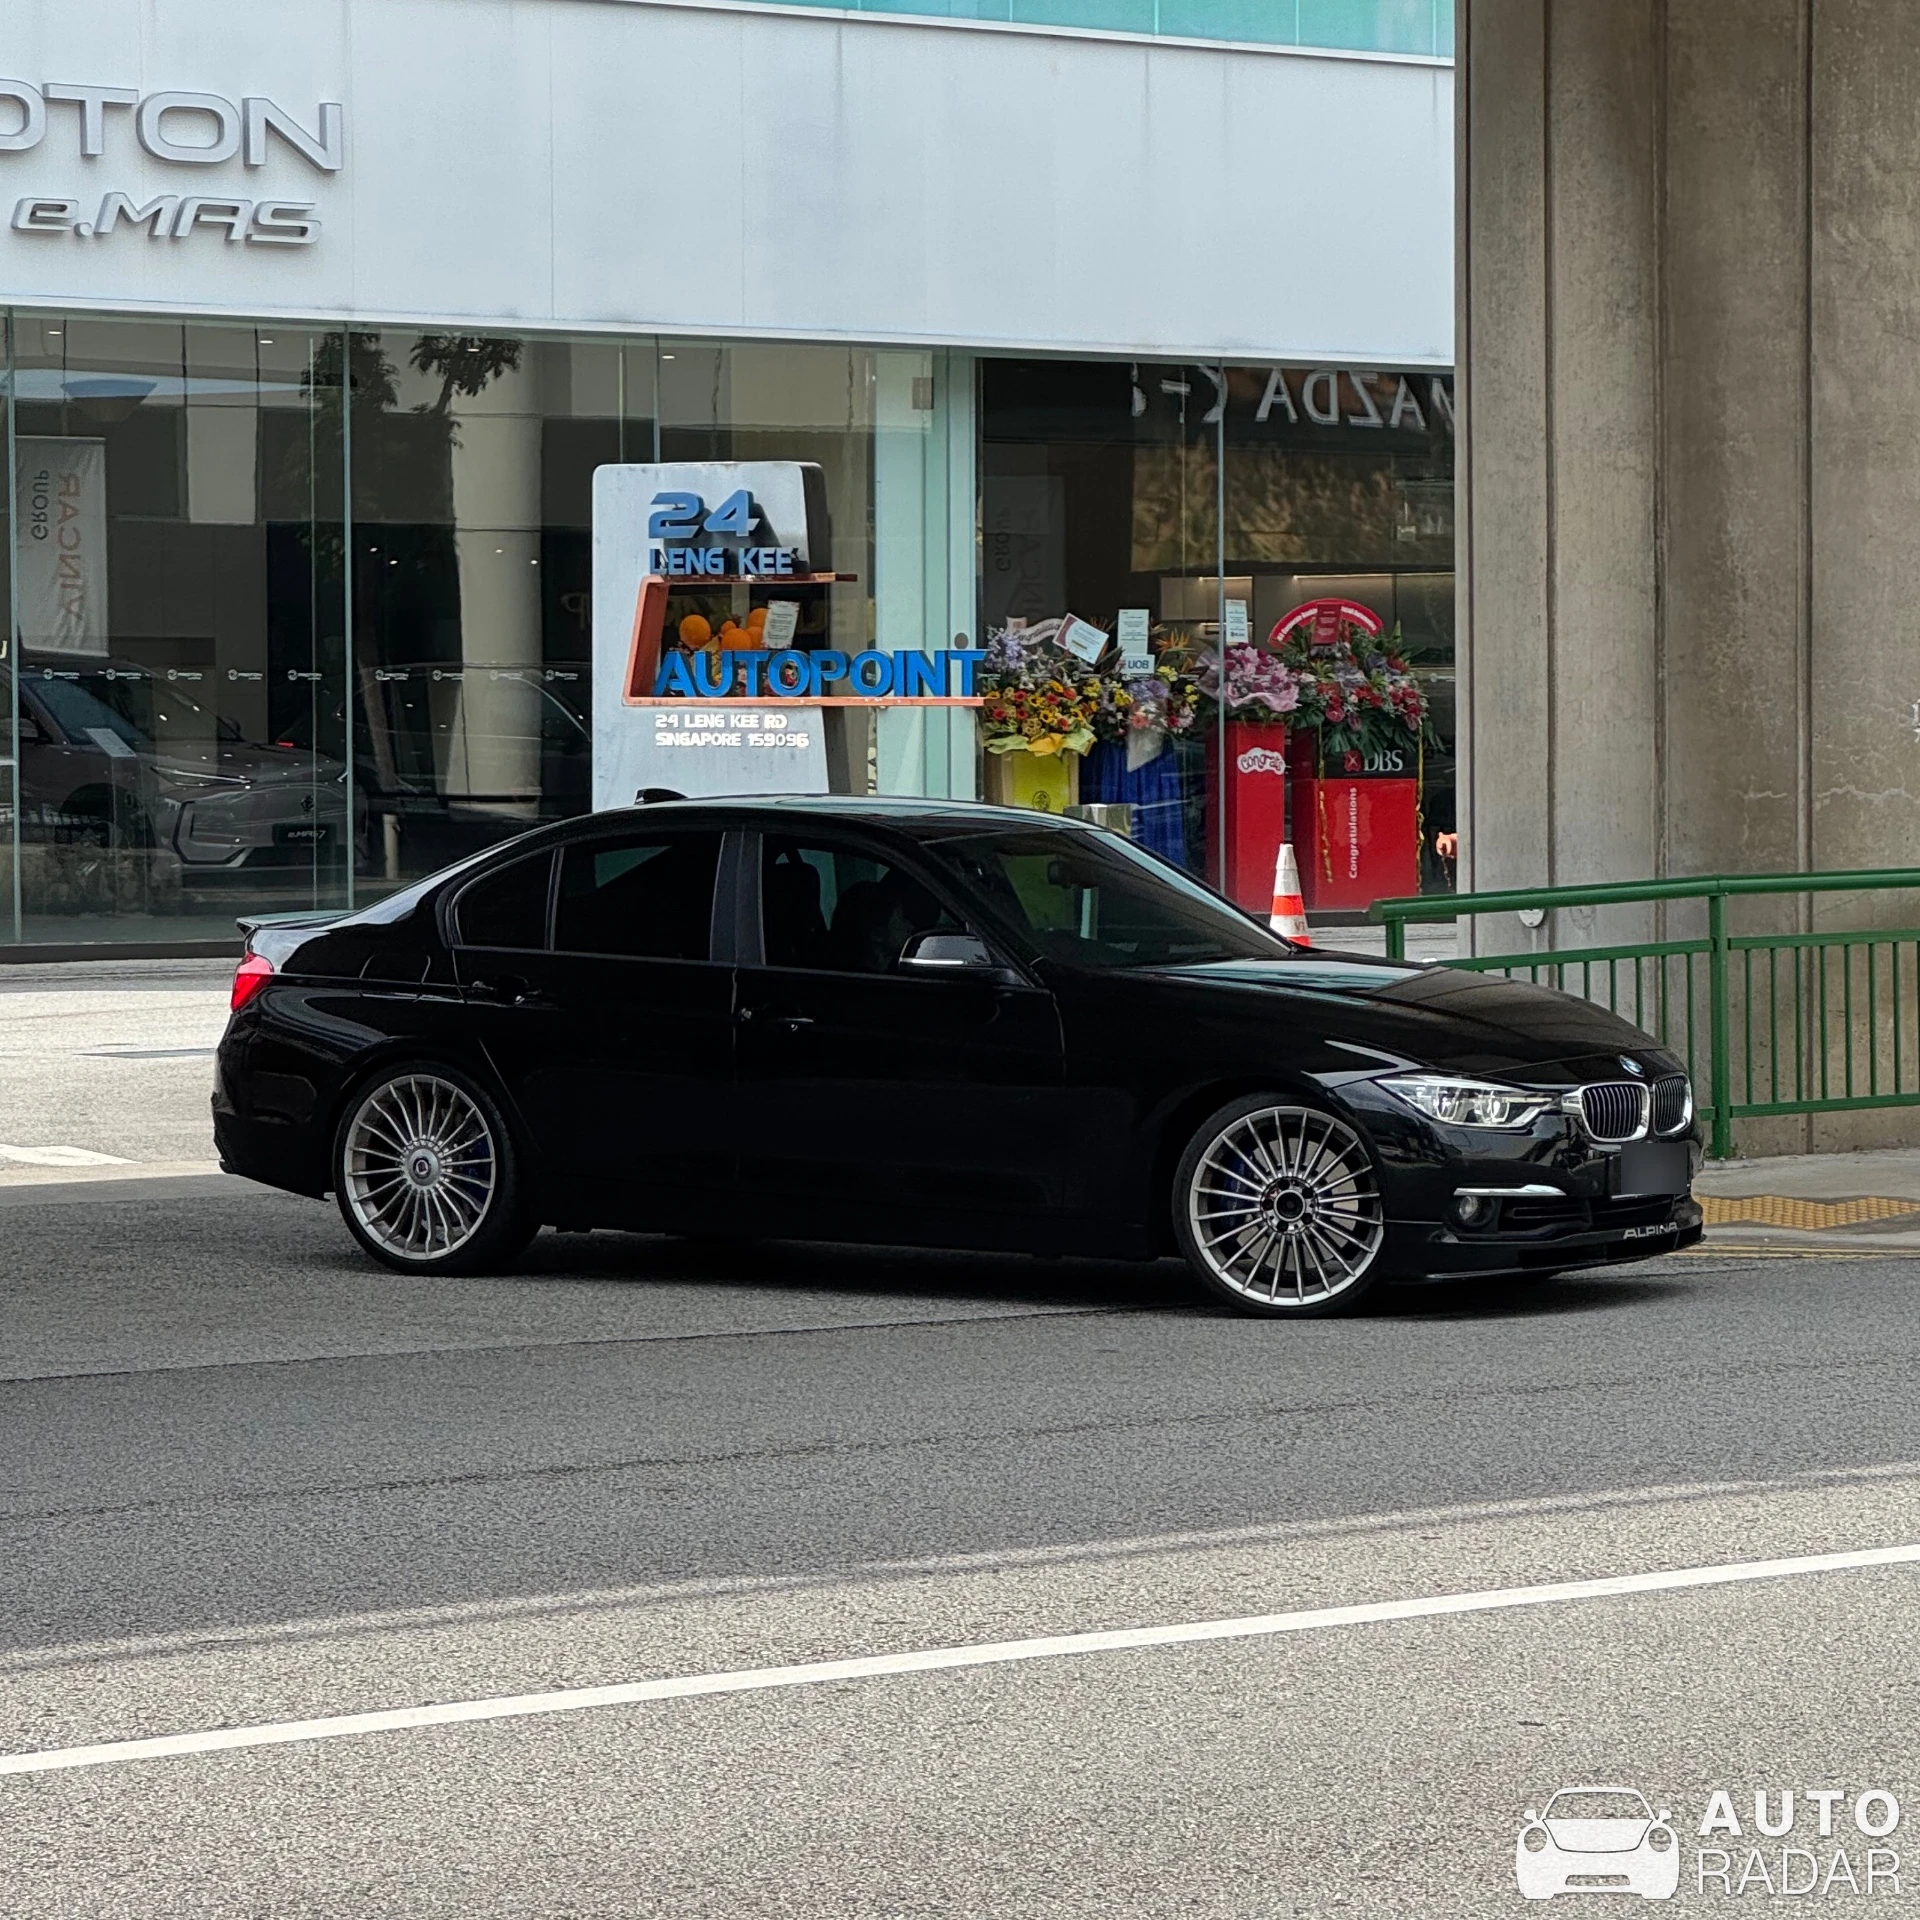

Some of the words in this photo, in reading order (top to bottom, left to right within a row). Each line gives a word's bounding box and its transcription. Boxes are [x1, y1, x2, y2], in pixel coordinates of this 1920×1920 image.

[11, 192, 322, 245] e.MAS
[648, 489, 760, 539] 24
[650, 548, 725, 574] LENG
[738, 548, 793, 574] KEE
[653, 650, 988, 697] AUTOPOINT
[1128, 660, 1149, 669] UOB
[655, 715, 678, 727] 24
[684, 715, 725, 728] LENG
[730, 715, 760, 728] KEE
[764, 715, 787, 728] RD
[655, 733, 741, 746] SINGAPORE
[748, 733, 809, 747] 159096
[1240, 753, 1283, 773] Congrats
[1364, 750, 1403, 771] DBS
[1348, 787, 1357, 879] Congratulations
[1623, 1221, 1678, 1239] ALPINA
